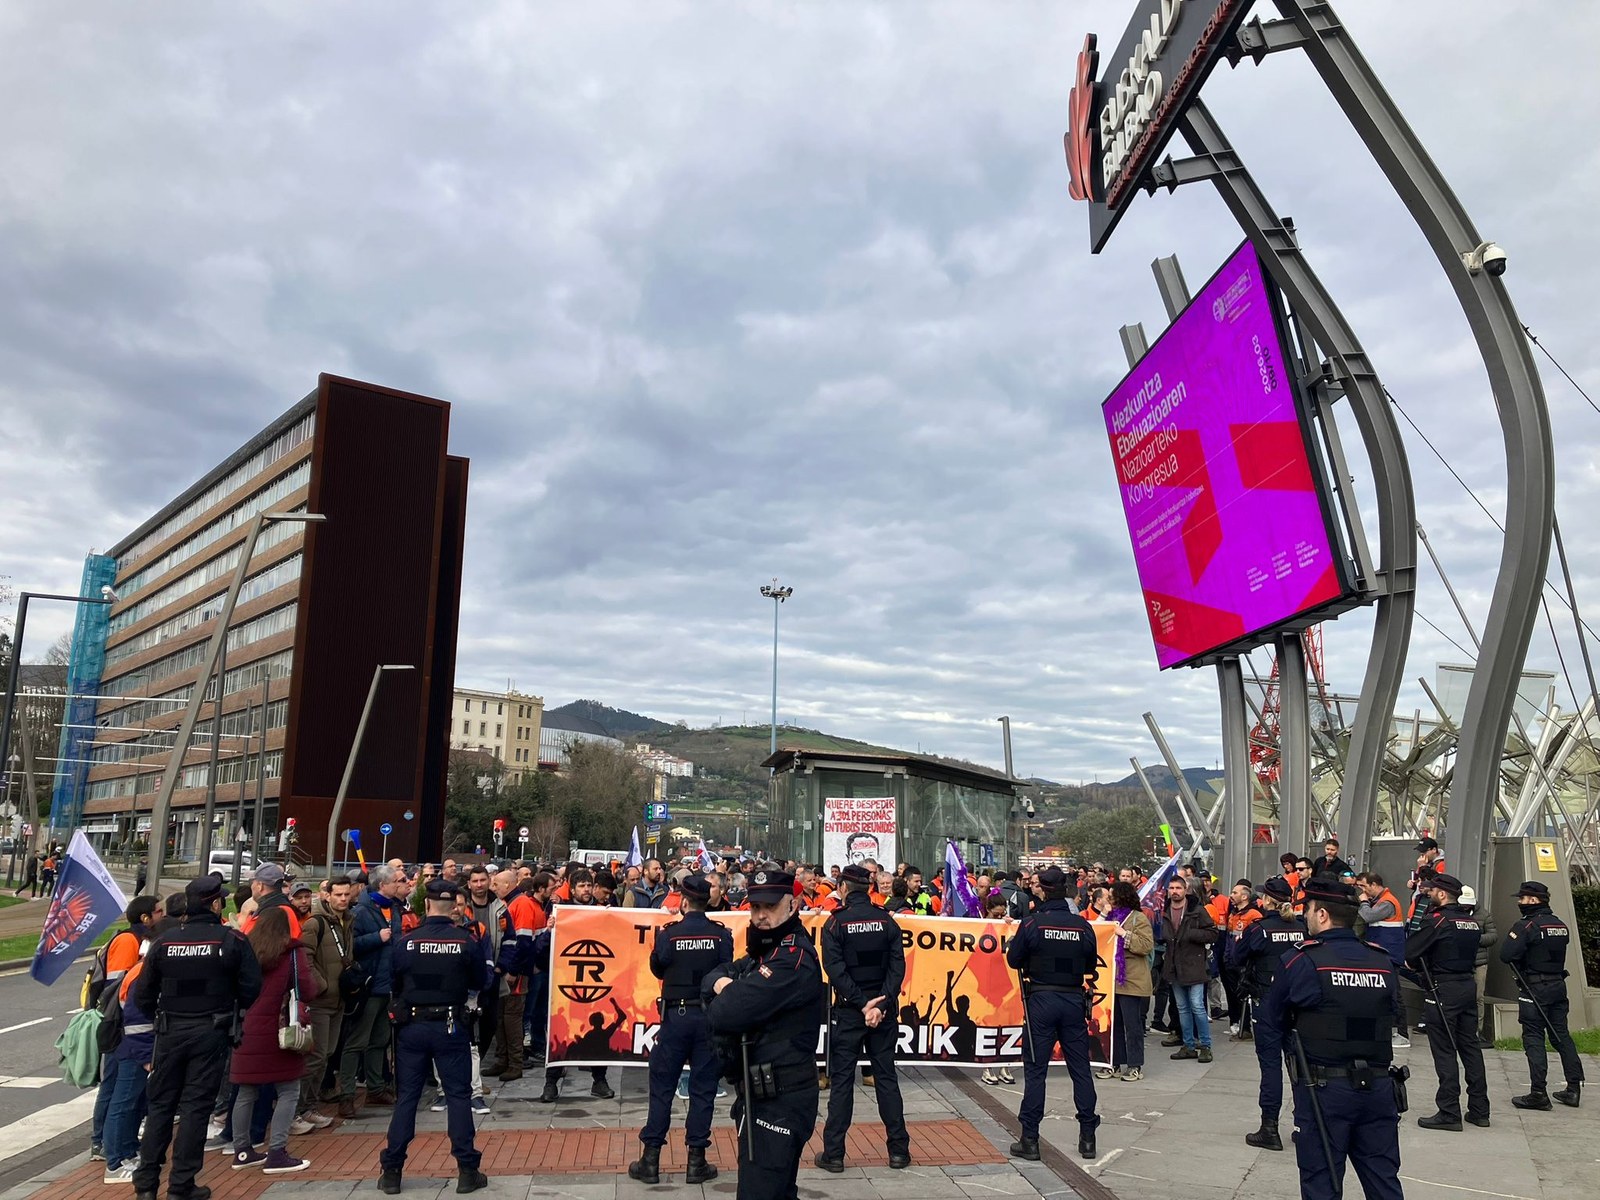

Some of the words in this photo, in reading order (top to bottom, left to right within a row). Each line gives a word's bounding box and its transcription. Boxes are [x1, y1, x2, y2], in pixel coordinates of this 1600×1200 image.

[1103, 71, 1163, 190] BILBAO
[1111, 371, 1163, 435] Hezkuntza
[1116, 380, 1187, 459] Ebaluazioaren
[1121, 422, 1179, 483] Nazioarteko
[1126, 453, 1180, 507] Kongresua
[825, 799, 854, 809] QUIERE
[856, 798, 895, 809] DESPEDIR
[851, 810, 893, 820] PERSONAS
[825, 822, 834, 832] EN
[834, 821, 860, 833] TUBOS
[861, 821, 896, 833] REUNIDOS
[848, 922, 884, 934] ERTZAINTZA
[1455, 920, 1480, 931] ERTZAINTZA
[1044, 929, 1080, 942] ERTZAINTZA
[167, 944, 211, 957] ERTZAINTZA
[420, 943, 461, 954] ERTZAINTZA
[676, 939, 715, 951] ERTZAINTZA
[568, 960, 604, 983] TR
[1330, 971, 1387, 989] ERTZAINTZA
[975, 1026, 1024, 1057] EZ
[755, 1118, 791, 1136] ERTZAINTZA
